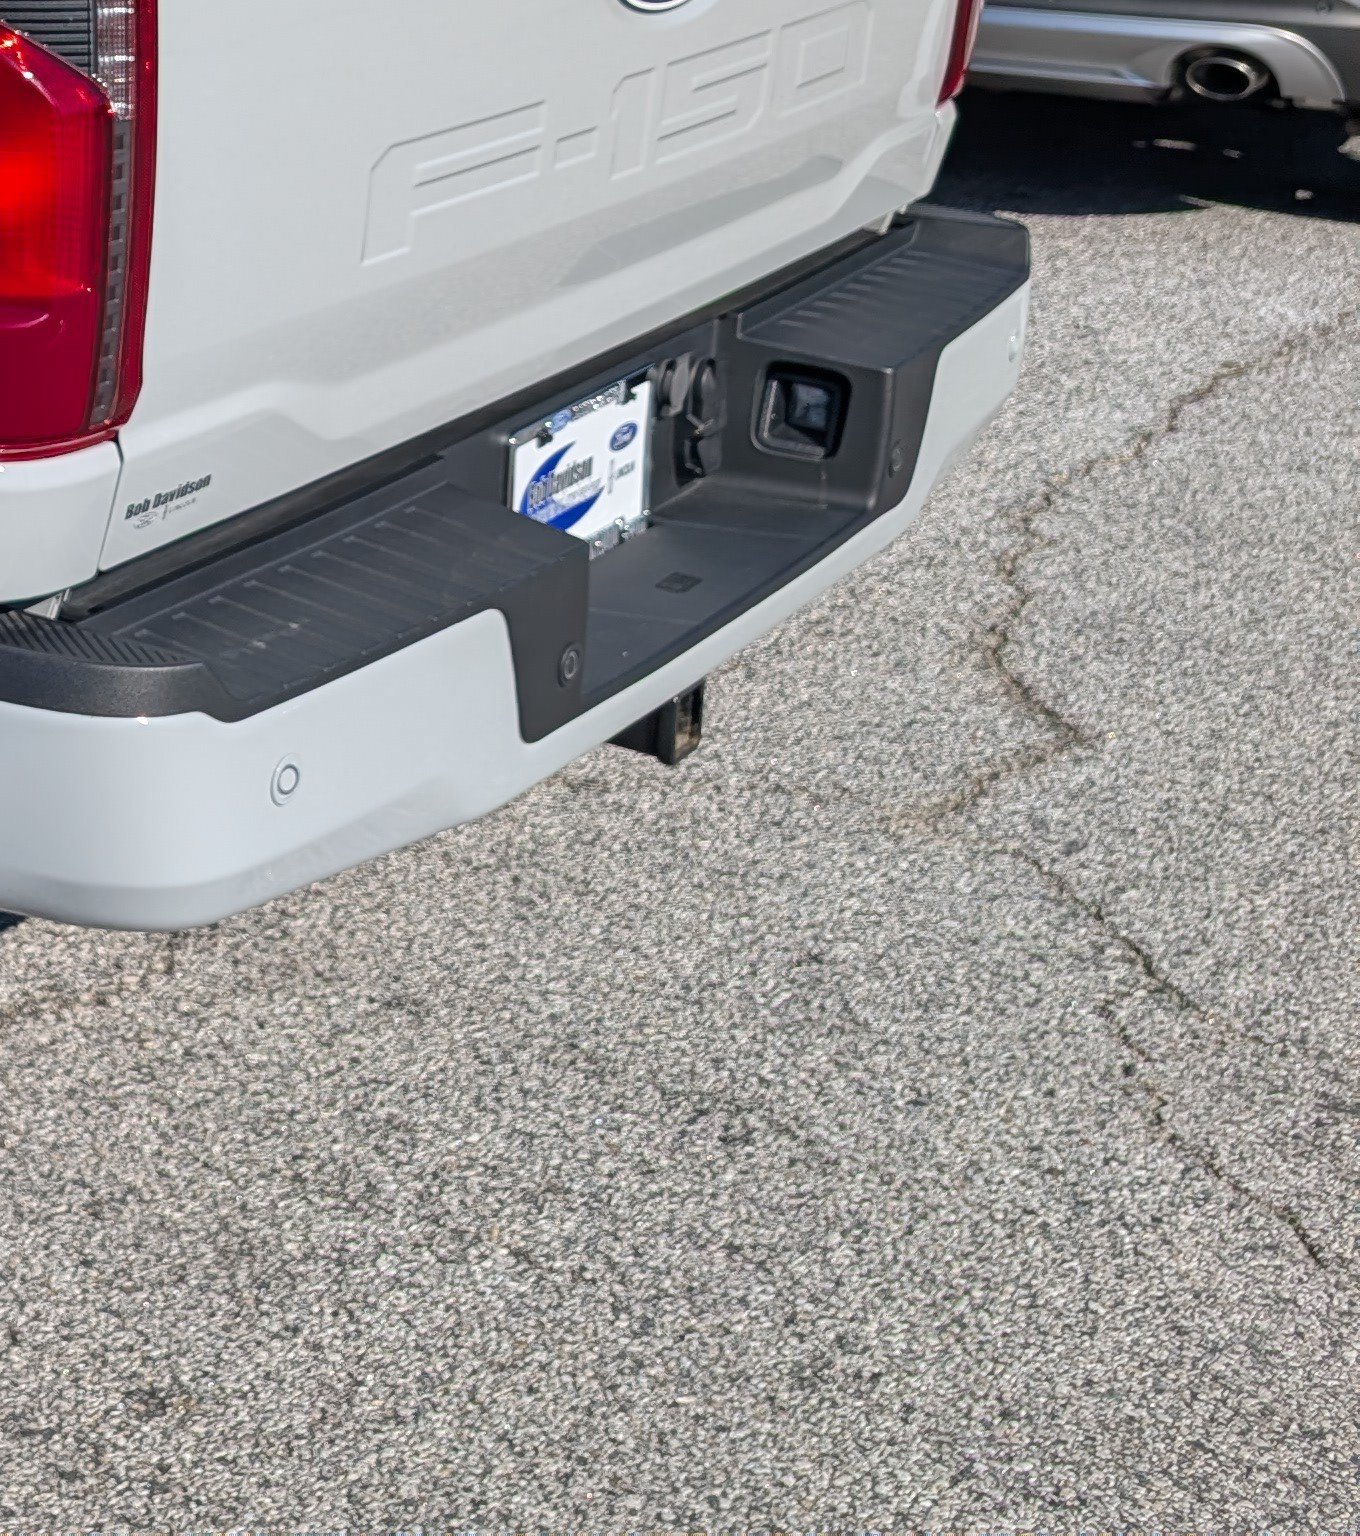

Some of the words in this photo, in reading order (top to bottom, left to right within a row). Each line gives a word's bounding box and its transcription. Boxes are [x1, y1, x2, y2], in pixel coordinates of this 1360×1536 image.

[124, 497, 152, 520] Bob
[152, 473, 212, 509] Davidson
[553, 455, 593, 495] Davidson
